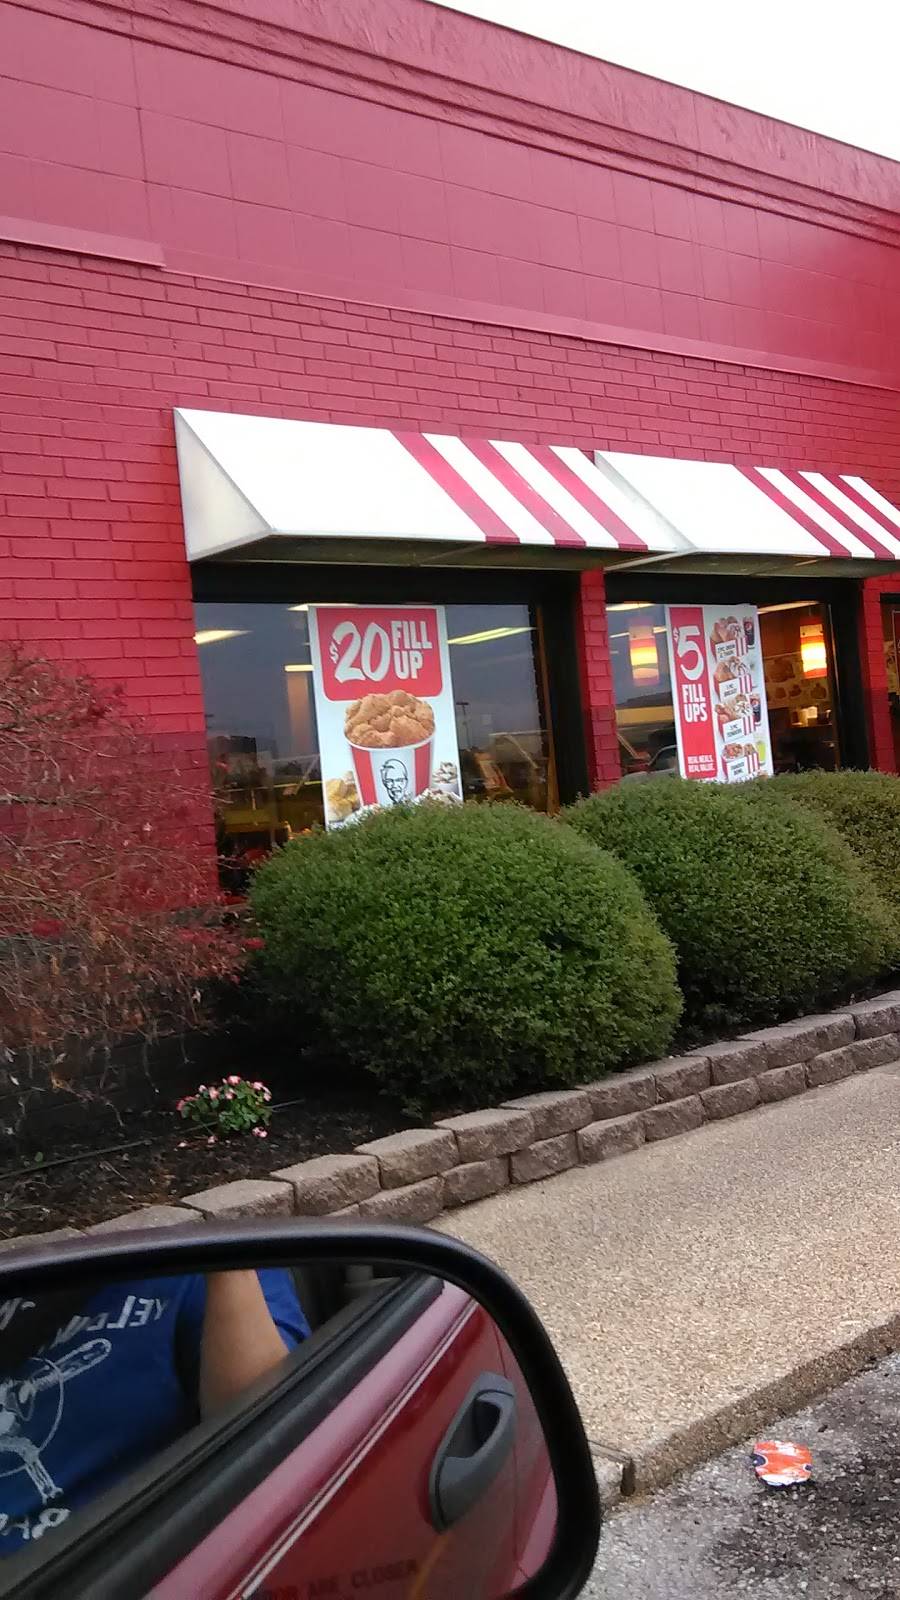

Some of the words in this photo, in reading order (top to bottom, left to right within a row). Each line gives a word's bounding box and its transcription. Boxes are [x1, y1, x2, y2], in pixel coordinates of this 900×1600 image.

[391, 620, 433, 649] FILL
[328, 621, 391, 683] $20
[393, 650, 424, 680] UP
[672, 625, 704, 681] $5
[681, 683, 706, 703] FILL
[683, 703, 708, 723] UPS
[351, 1559, 418, 1589] CLOSER
